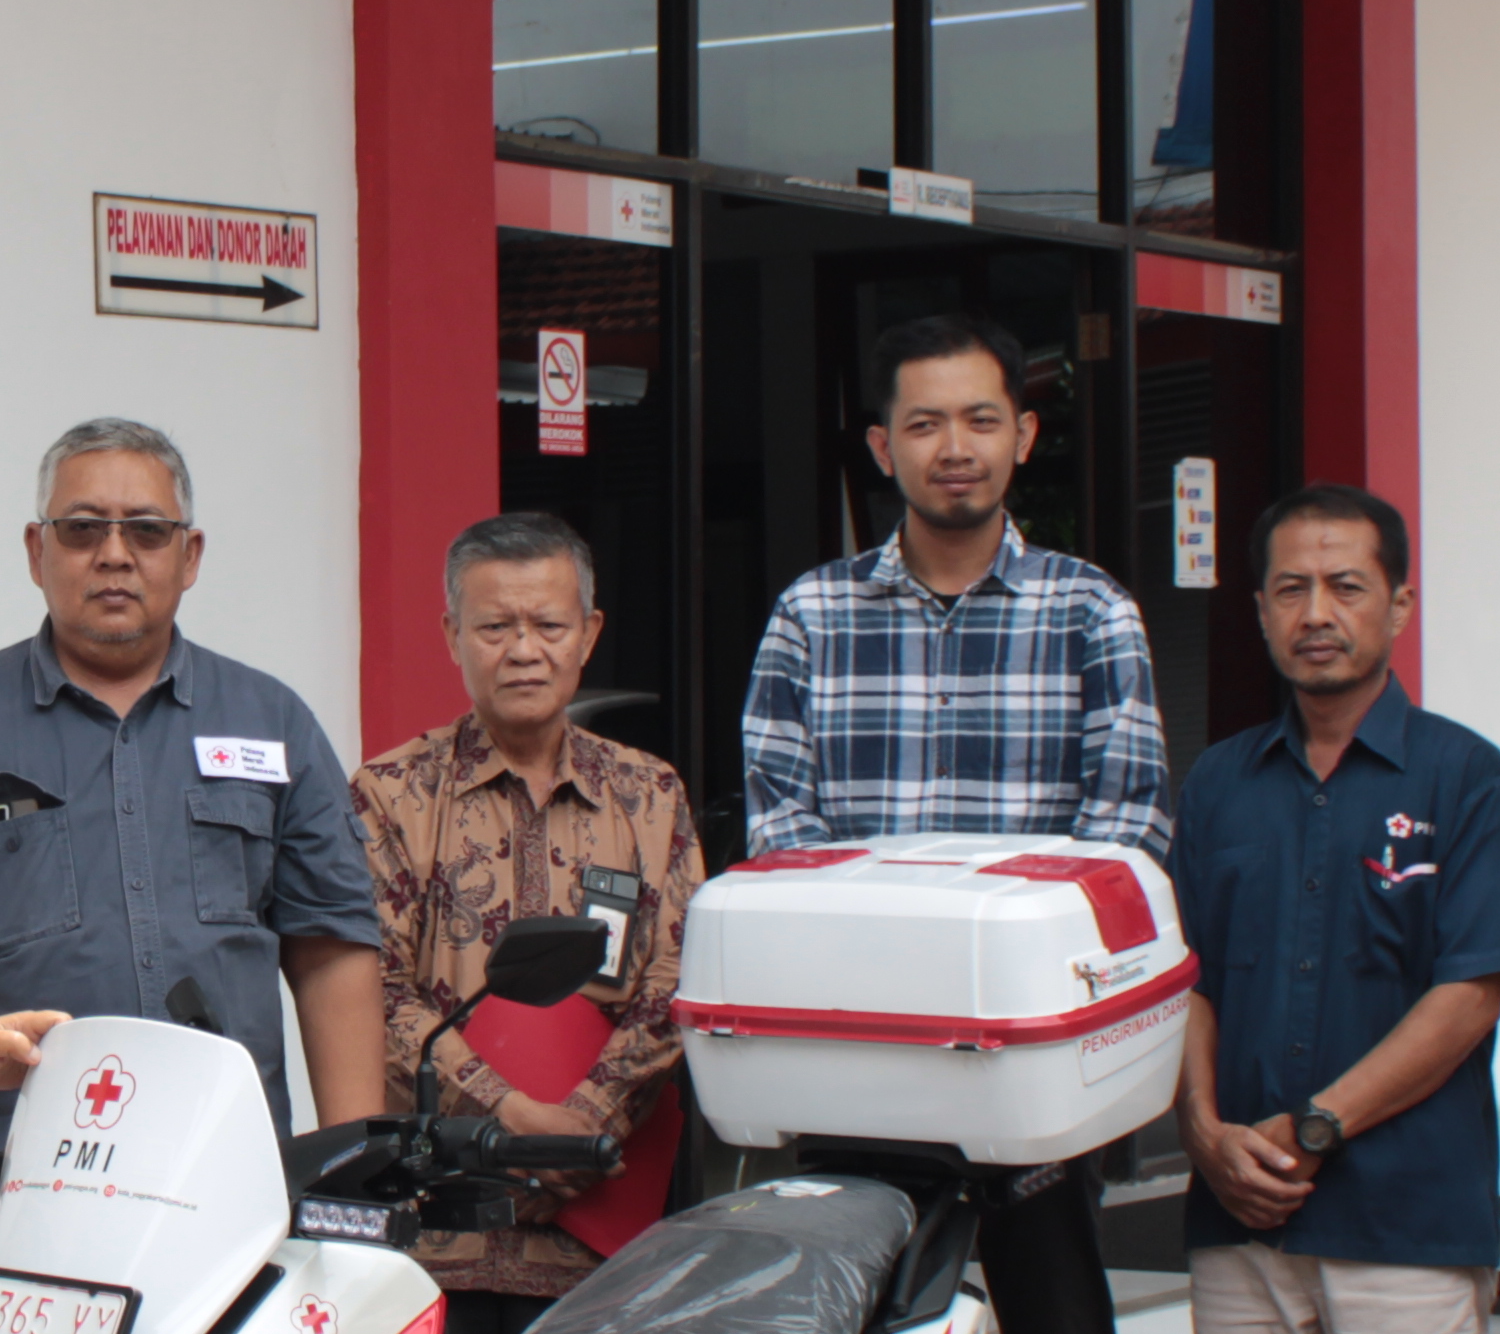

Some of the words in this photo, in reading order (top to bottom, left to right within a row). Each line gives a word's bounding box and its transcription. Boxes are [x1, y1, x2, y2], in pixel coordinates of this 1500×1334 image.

[107, 208, 183, 258] PELAYANAN
[187, 216, 214, 261] DAN
[217, 219, 262, 265] DONOR
[265, 223, 307, 269] DARAH
[539, 411, 584, 426] DILARANG
[539, 427, 584, 441] MEROKOK
[1081, 1010, 1160, 1056] PENGIRIMAN
[52, 1139, 116, 1173] PMI
